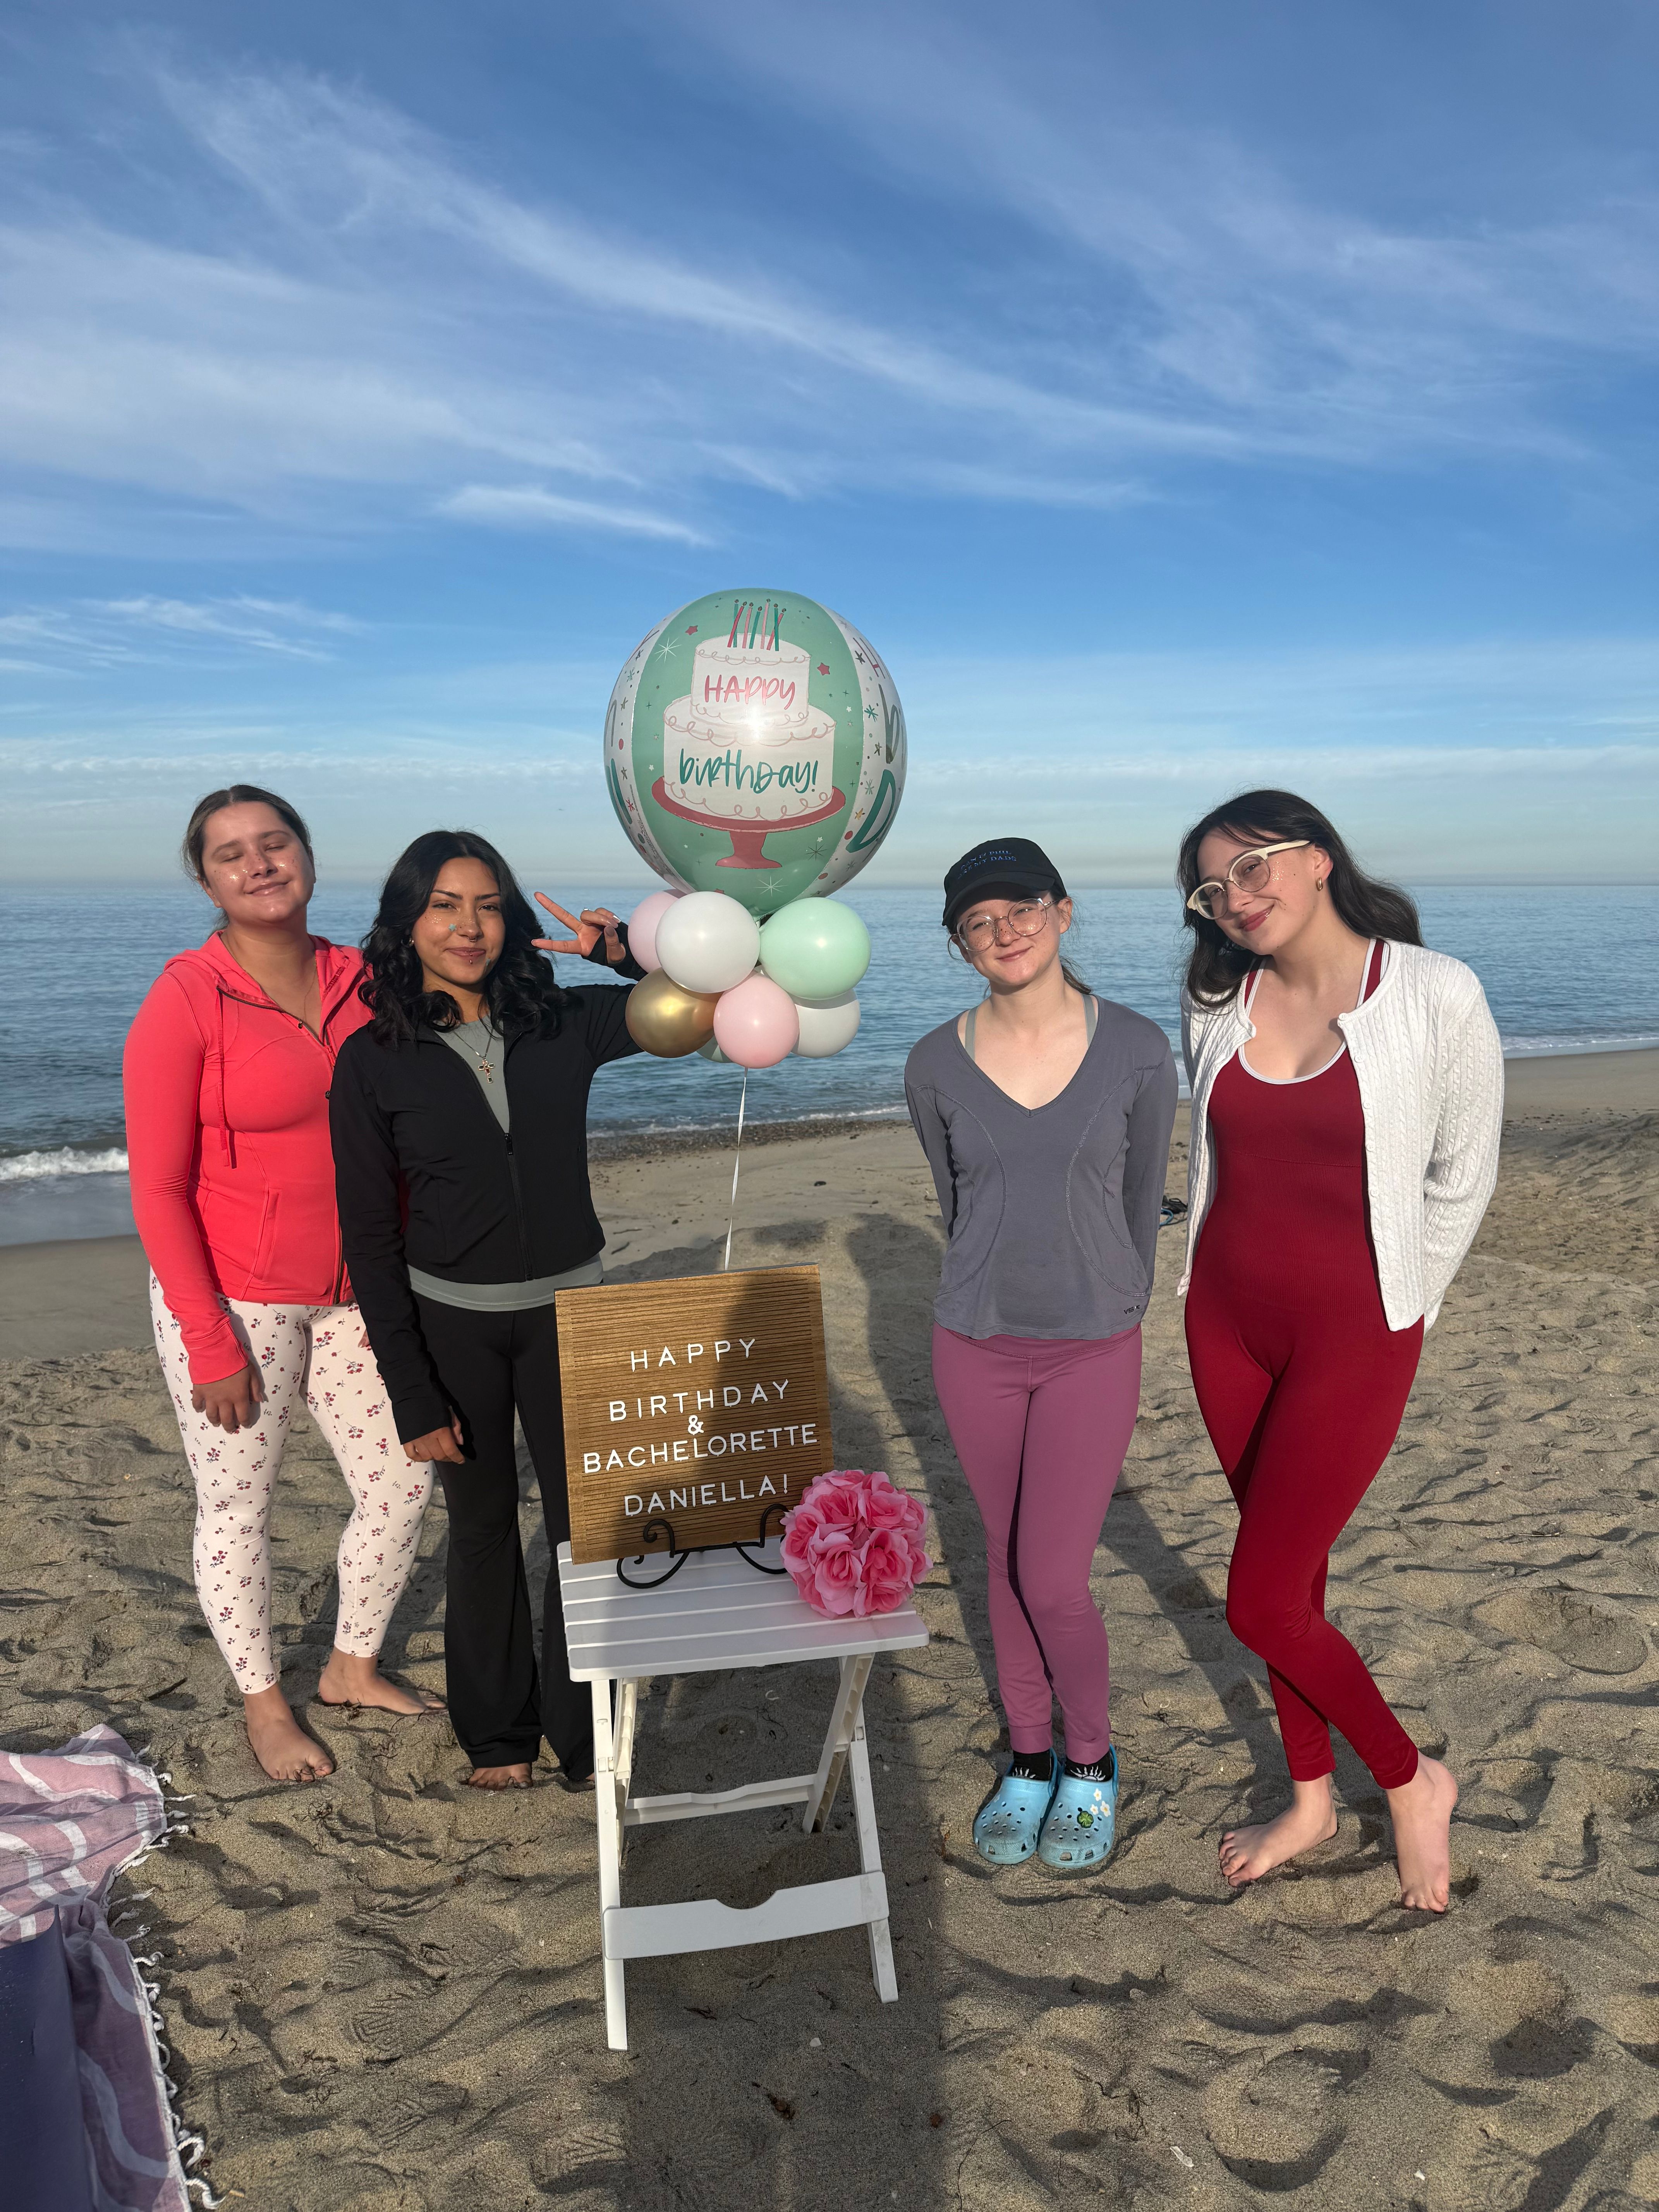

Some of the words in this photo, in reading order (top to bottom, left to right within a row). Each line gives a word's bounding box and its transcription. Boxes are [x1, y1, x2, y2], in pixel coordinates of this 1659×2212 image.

[704, 674, 795, 710] HAPPY
[630, 1338, 755, 1372] HAPPY
[609, 1379, 788, 1422] BIRTHDAY
[687, 1414, 704, 1436] &
[584, 1423, 817, 1474] BACHELORETTE
[624, 1474, 788, 1516] DANIELLA!
